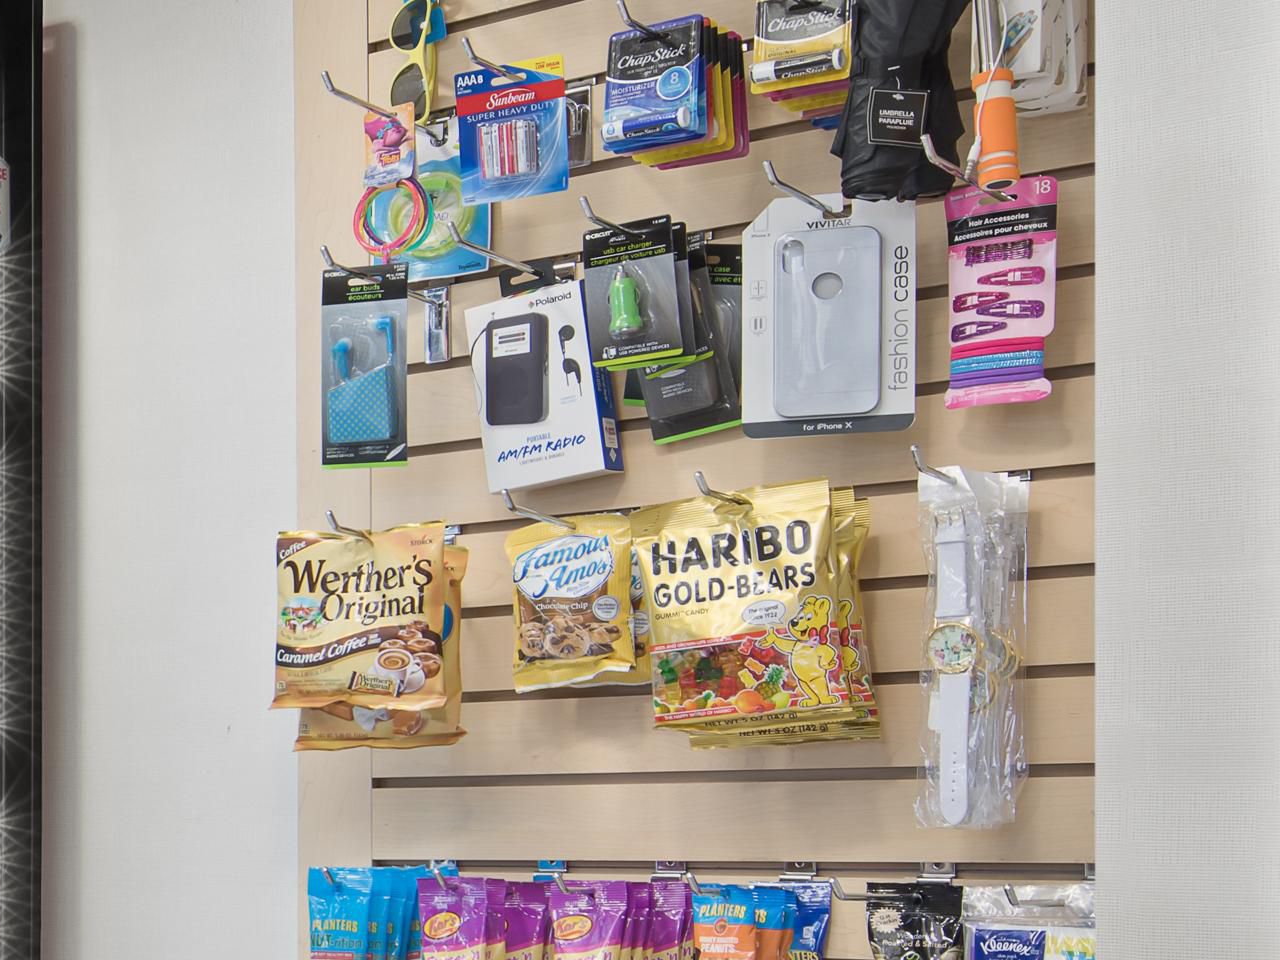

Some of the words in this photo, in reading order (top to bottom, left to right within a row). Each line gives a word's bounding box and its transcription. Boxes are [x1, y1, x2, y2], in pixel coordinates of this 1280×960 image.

[617, 43, 687, 70] ChapStick
[456, 73, 477, 88] AAA
[485, 88, 537, 110] Sunbeam
[466, 110, 496, 123] SUPER
[498, 105, 527, 119] HEAVY
[529, 99, 555, 112] DUTY
[879, 109, 915, 118] UMBRELLA
[878, 117, 914, 126] PARAPLUIE
[1034, 179, 1051, 194] 18
[806, 218, 852, 230] VIVITAR
[968, 216, 988, 228] Hair
[989, 211, 1030, 226] Accessories
[994, 225, 1012, 238] pour
[603, 247, 617, 256] usb
[630, 240, 653, 251] charger
[893, 245, 909, 303] case
[363, 283, 380, 292] buds
[535, 291, 572, 308] Polaroid
[888, 307, 909, 392] fashion
[803, 423, 814, 431] for
[816, 421, 843, 431] iPhone
[845, 421, 853, 429] X
[547, 434, 587, 454] RADIO
[279, 539, 306, 560] Coffee
[513, 535, 611, 579] Famous
[651, 518, 812, 576] HARIBO
[284, 553, 434, 596] Werther's
[653, 562, 816, 608] GOLD-BEARS
[319, 590, 426, 626] Original
[535, 603, 569, 612] Chocolate
[570, 602, 589, 612] Chip
[276, 643, 326, 665] Caramel
[327, 637, 368, 658] Coffee
[312, 918, 358, 933] PLANTERS
[978, 938, 1032, 958] Kleenex
